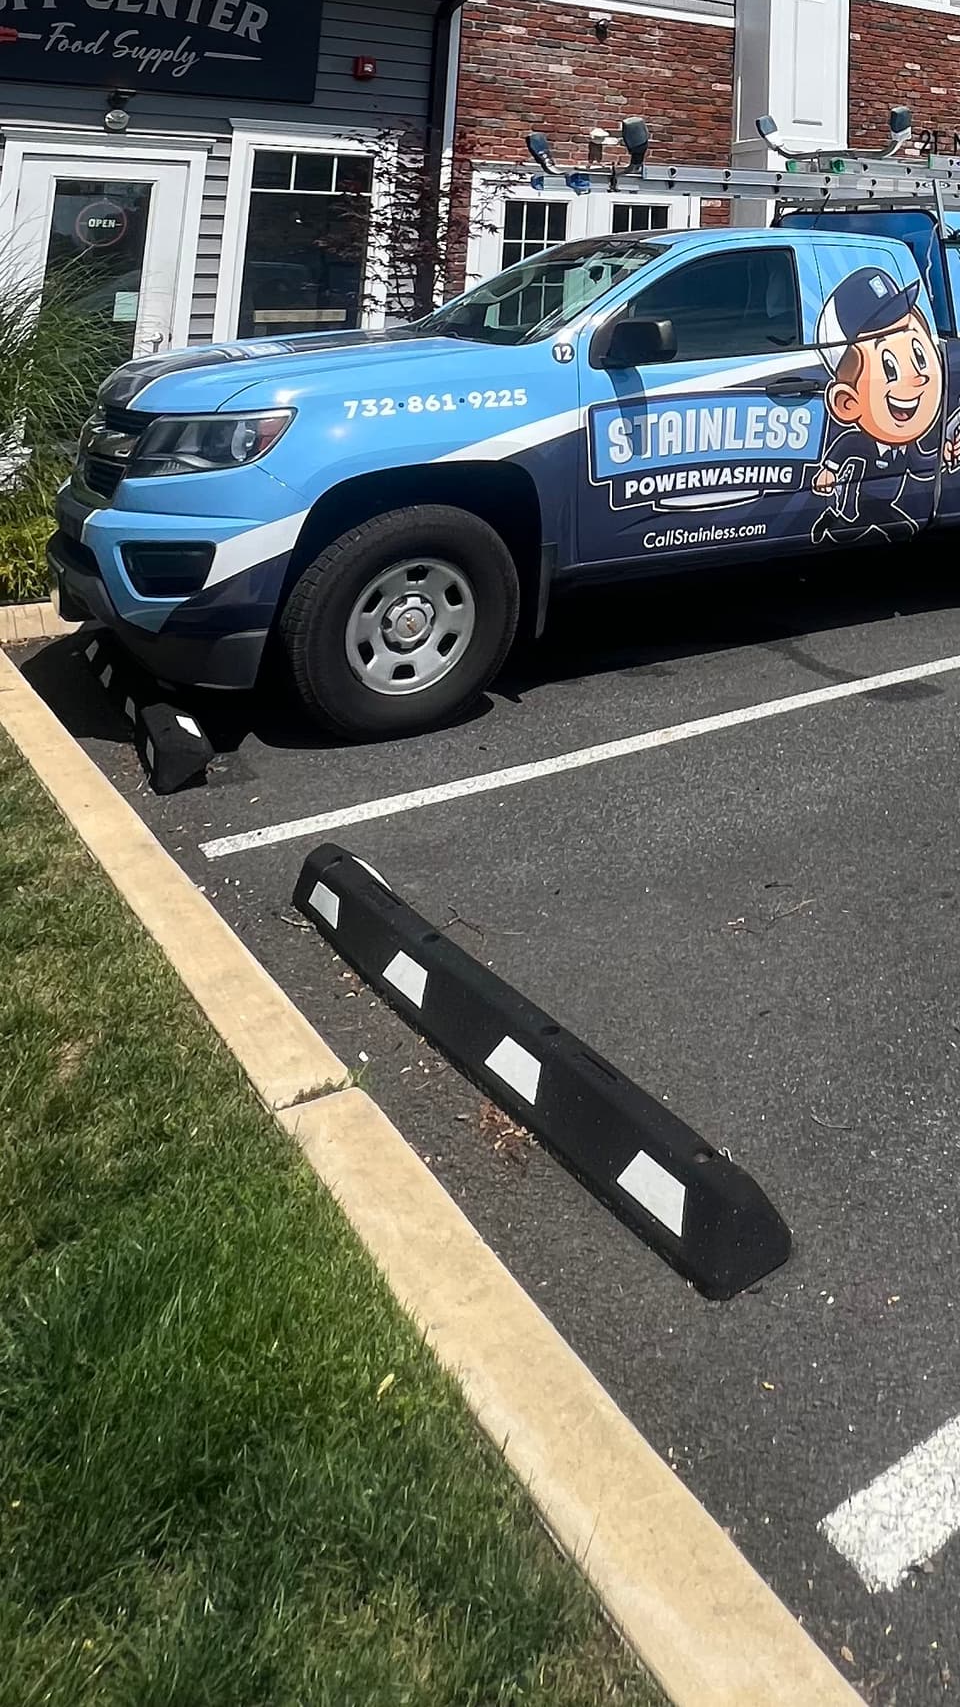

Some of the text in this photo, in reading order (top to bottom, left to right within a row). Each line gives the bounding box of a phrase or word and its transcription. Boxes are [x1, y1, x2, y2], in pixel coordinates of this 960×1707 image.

[44, 21, 201, 78] Food Supply
[88, 218, 117, 228] OPEN
[553, 346, 573, 361] 12
[608, 405, 812, 465] STAINLESS
[624, 466, 793, 499] POWERWASHING
[643, 522, 767, 549] CallStainless.com
